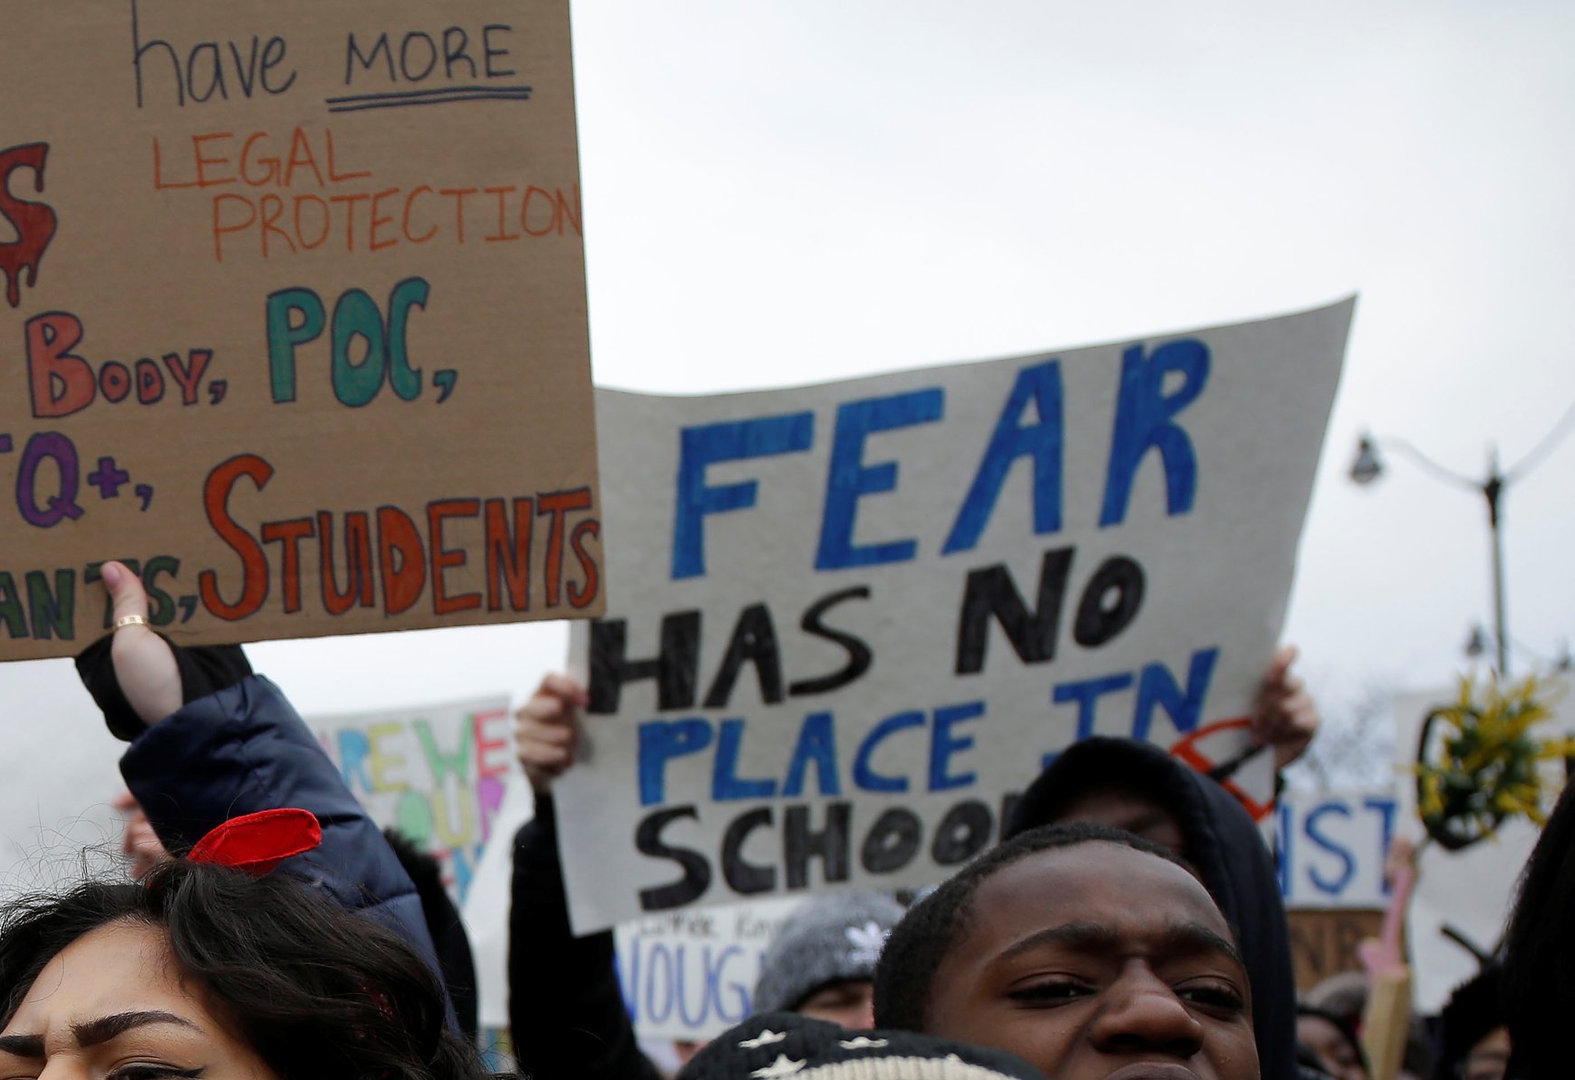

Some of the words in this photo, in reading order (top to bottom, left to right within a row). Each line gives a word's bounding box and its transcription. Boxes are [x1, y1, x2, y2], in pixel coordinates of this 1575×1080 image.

[132, 0, 296, 109] have
[346, 25, 515, 82] MORE
[154, 126, 371, 189] LEGAL
[212, 185, 581, 262] PROTECTION
[267, 276, 456, 406] POC,
[671, 337, 1211, 580] FEAR
[199, 454, 601, 621] STUDENTS
[586, 585, 873, 714] HAS
[955, 545, 1146, 675] NO
[319, 722, 410, 794] RE
[637, 702, 986, 806] PLACE
[1042, 647, 1220, 769] IN
[636, 792, 1019, 910] SCHOO
[612, 935, 764, 1029] NOUG
